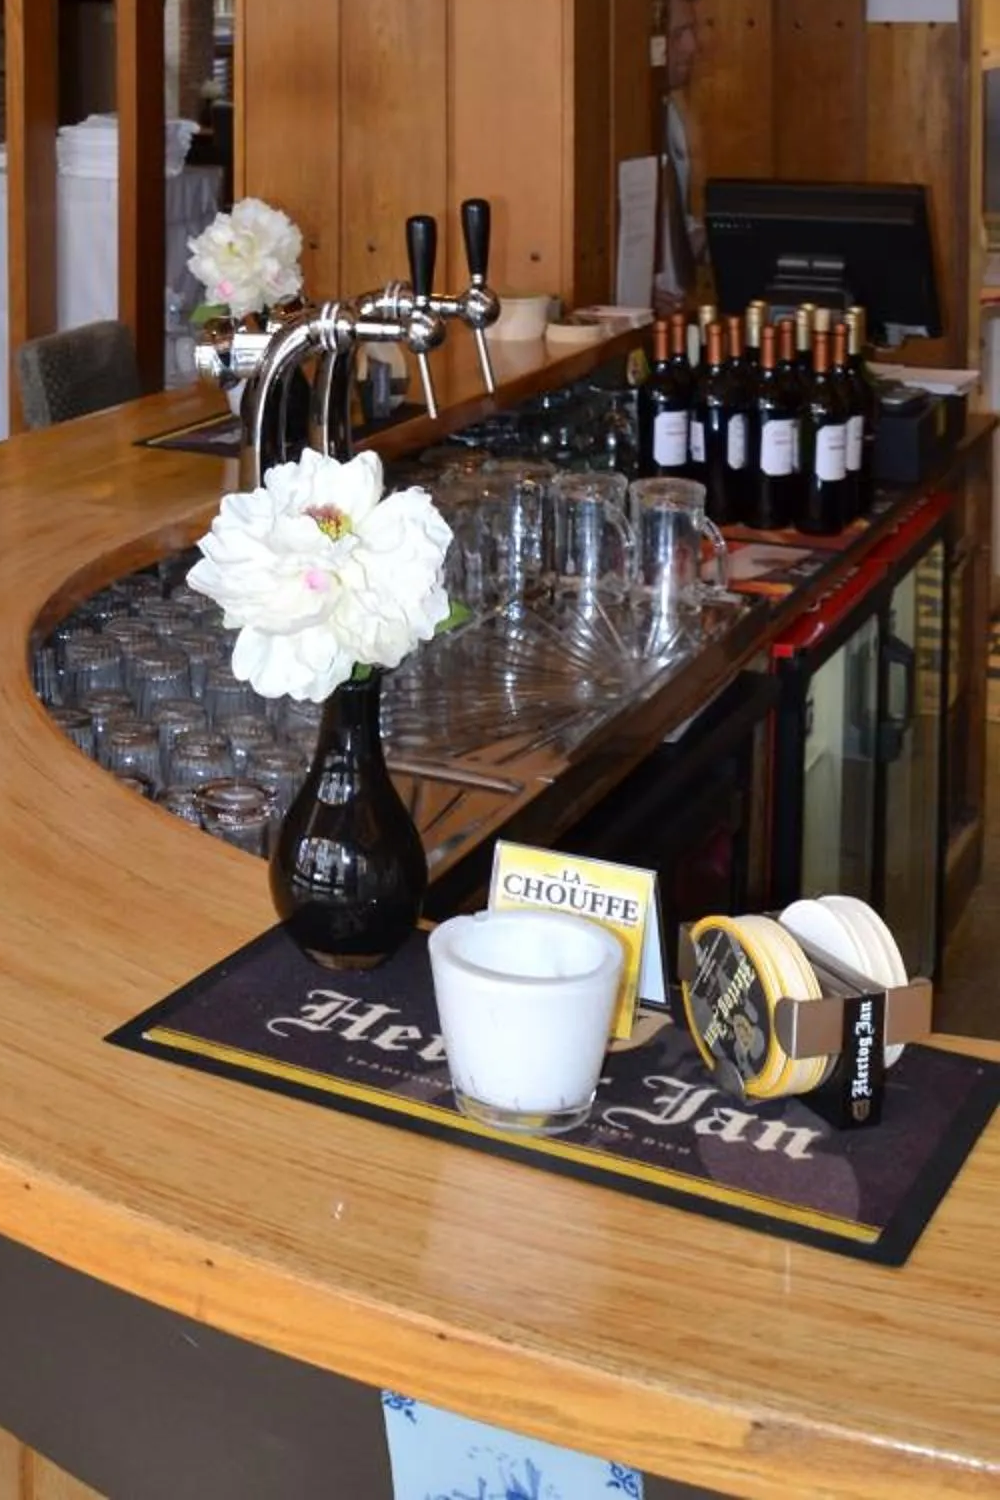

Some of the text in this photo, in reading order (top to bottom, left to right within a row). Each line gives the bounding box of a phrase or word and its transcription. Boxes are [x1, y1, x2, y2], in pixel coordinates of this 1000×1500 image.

[503, 873, 640, 922] CHOUFFE
[562, 869, 581, 885] LA
[851, 1000, 876, 1098] Hertog Jan
[601, 1074, 823, 1160] Jan
